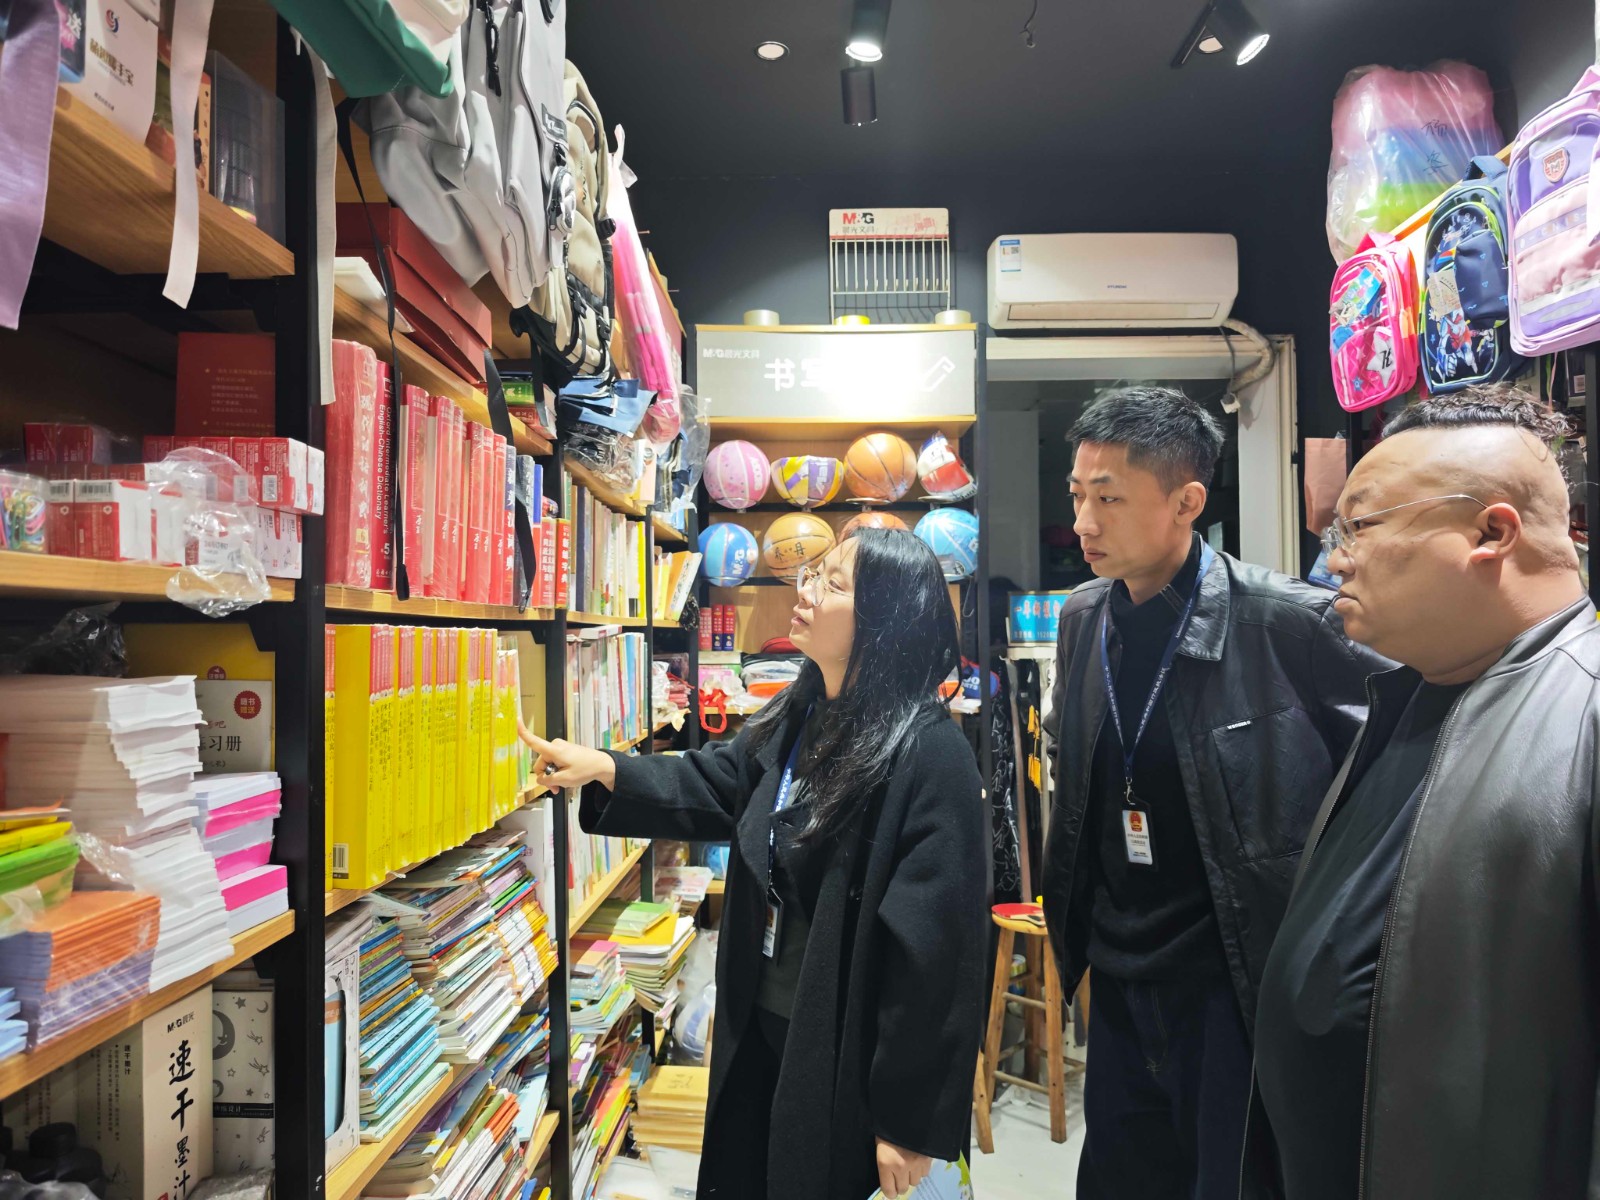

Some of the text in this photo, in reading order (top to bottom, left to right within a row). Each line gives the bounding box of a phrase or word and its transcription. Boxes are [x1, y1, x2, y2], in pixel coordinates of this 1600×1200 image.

[842, 212, 875, 225] M&G
[374, 403, 385, 520] English-Chinese Dictionary
[383, 542, 391, 555] 5
[168, 1039, 197, 1200] 速干墨汁
